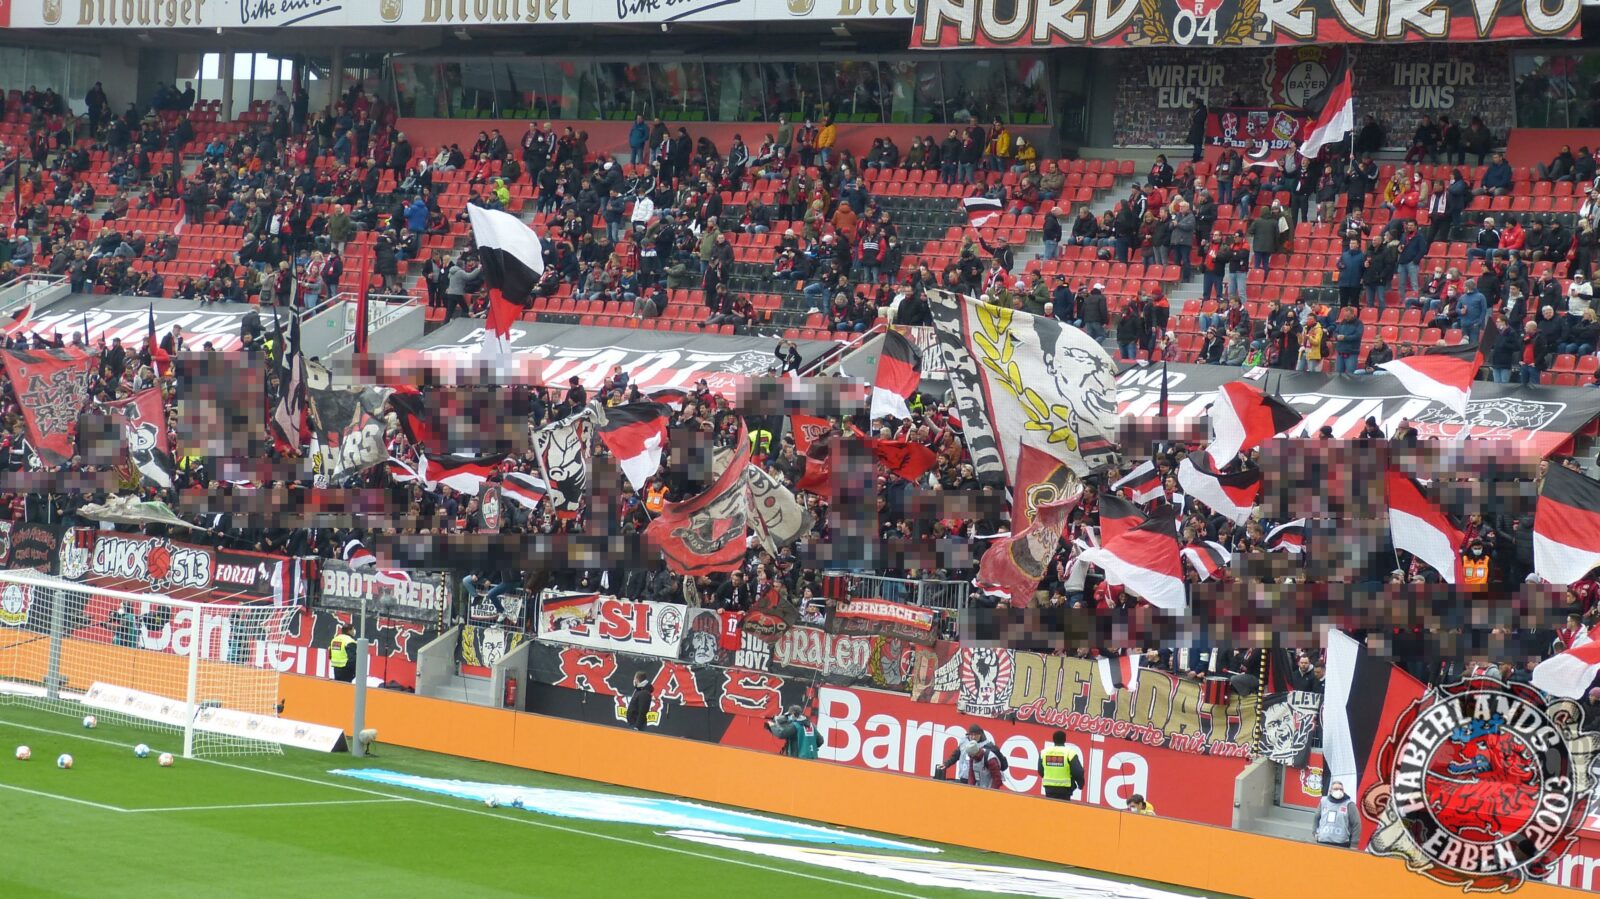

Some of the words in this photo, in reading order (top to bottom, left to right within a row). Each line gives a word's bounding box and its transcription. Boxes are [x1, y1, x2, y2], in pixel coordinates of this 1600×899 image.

[1173, 9, 1218, 45] 04
[1147, 65, 1187, 87] WIR
[1187, 60, 1225, 87] FÜR
[1394, 62, 1431, 86] IHR
[1431, 57, 1476, 86] FÜR
[1158, 87, 1209, 109] EUCH
[1410, 86, 1455, 109] UNS
[92, 536, 147, 581] CHAOS
[172, 549, 211, 588] 513
[215, 563, 256, 585] FORZA
[727, 618, 738, 633] 17
[734, 650, 770, 672] BOYZ
[1016, 698, 1164, 746] Ausgesperrte
[1170, 731, 1206, 754] mit
